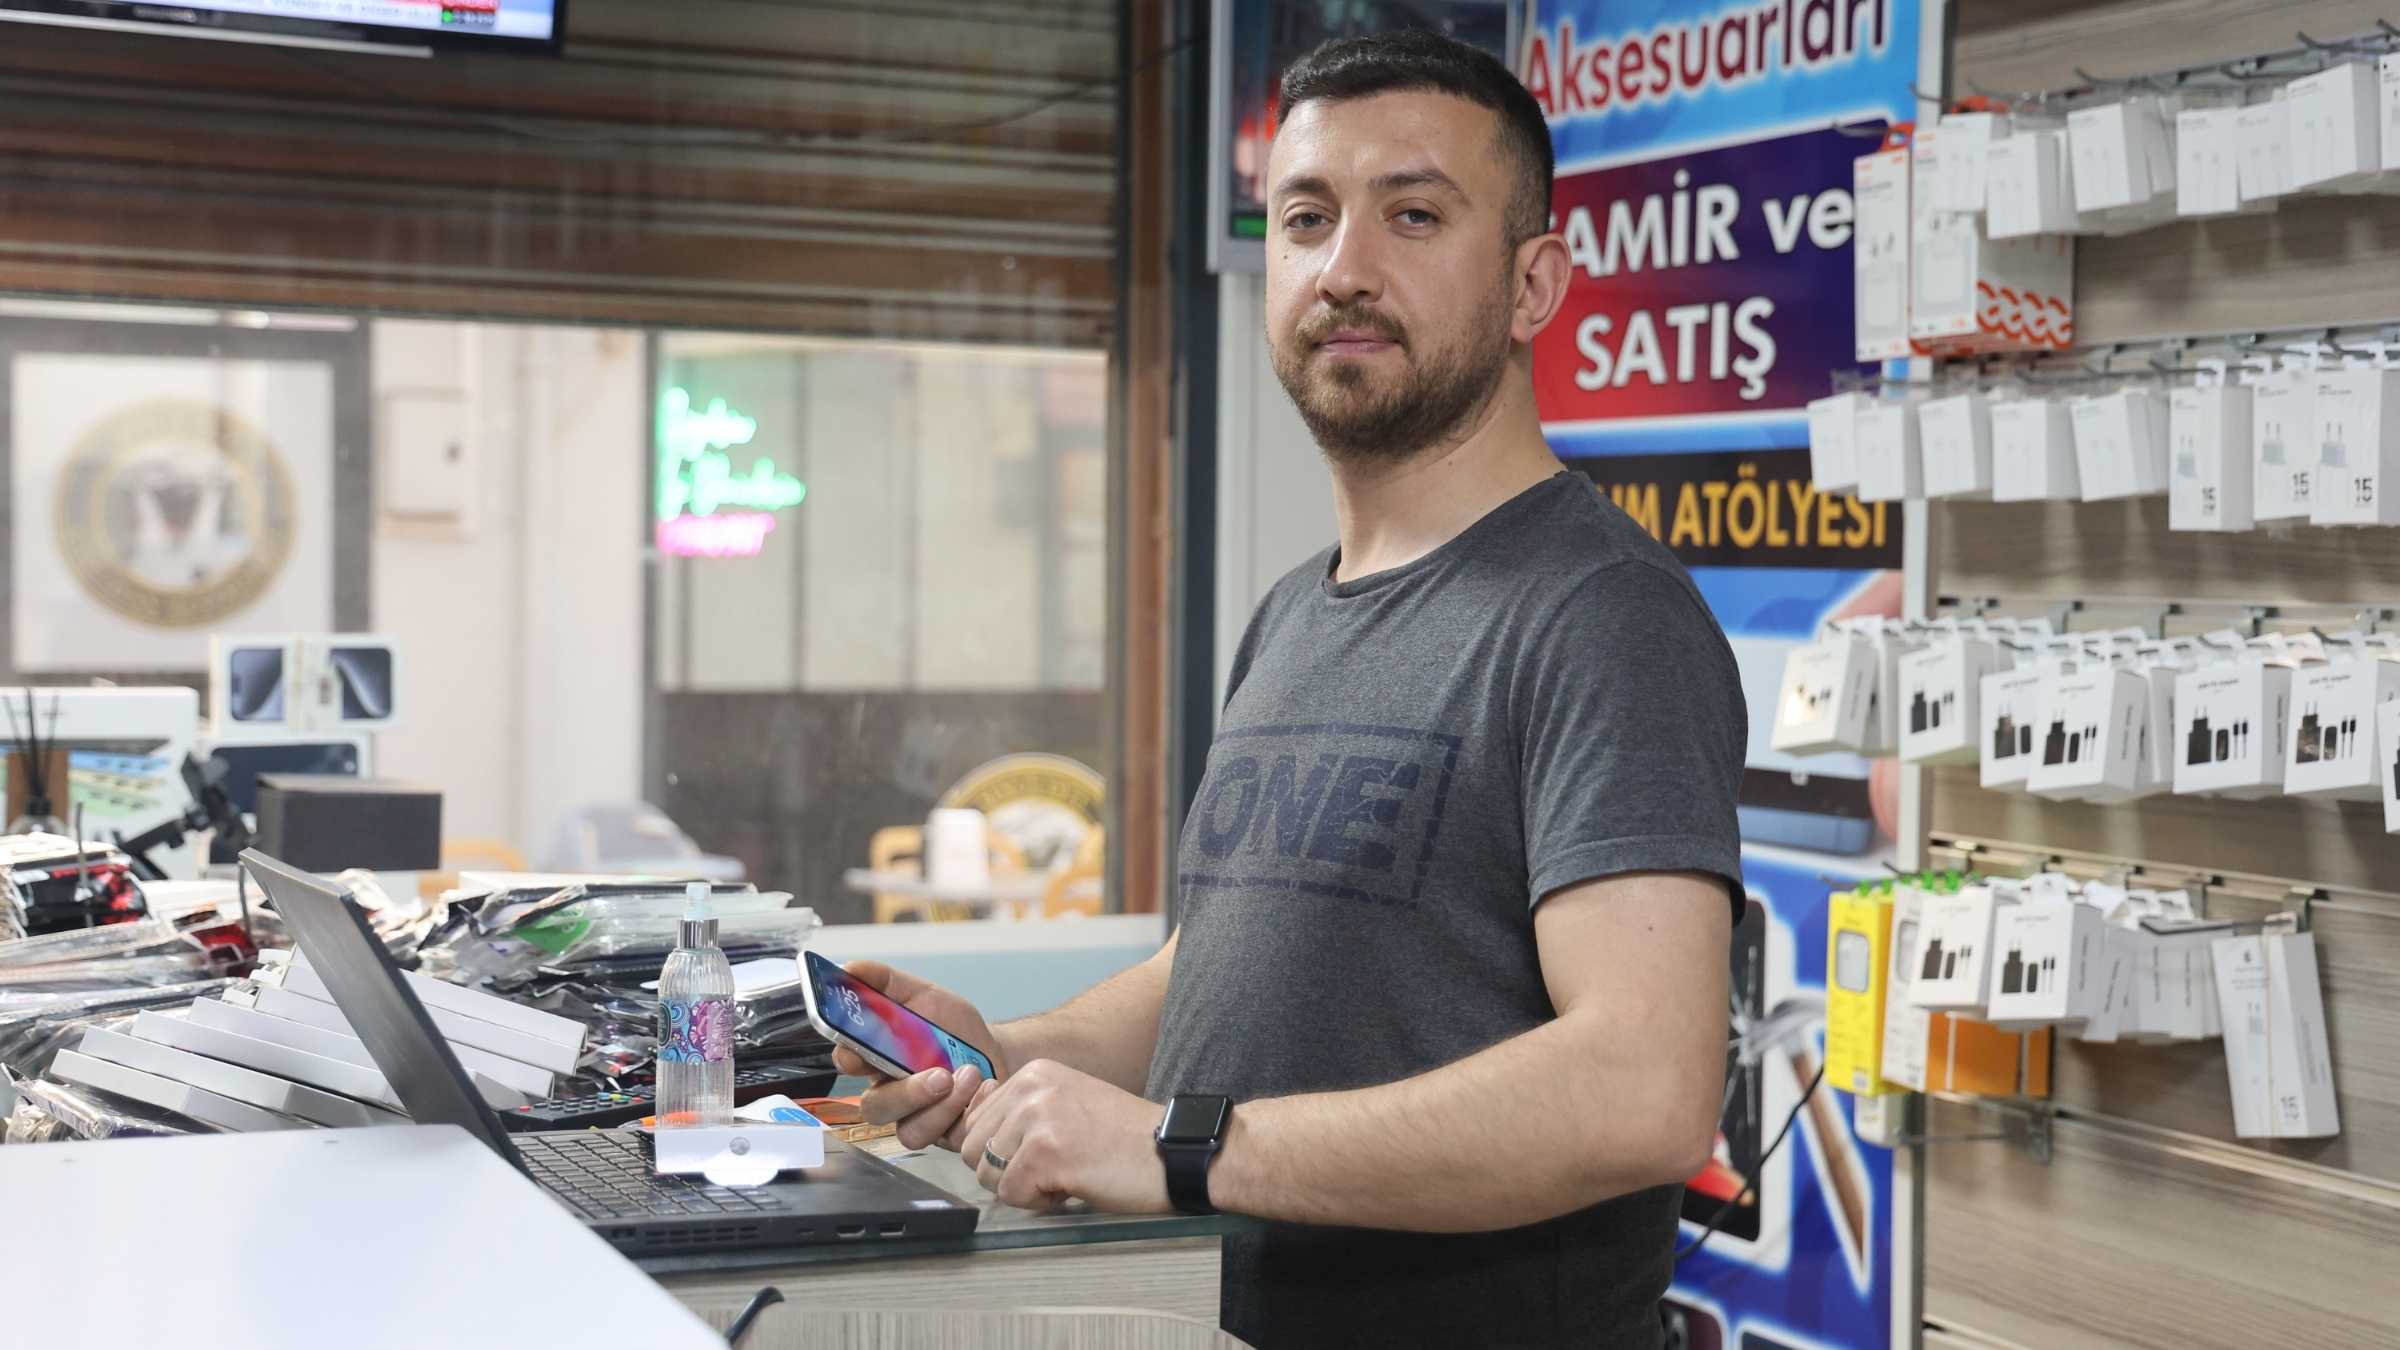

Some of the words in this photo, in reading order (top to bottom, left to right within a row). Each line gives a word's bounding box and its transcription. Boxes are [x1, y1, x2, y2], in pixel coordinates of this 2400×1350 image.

[1550, 168, 1740, 278] AMİR
[1761, 187, 1854, 254] ve
[1574, 296, 1777, 401] SATIŞ
[1199, 754, 1421, 869] ONE
